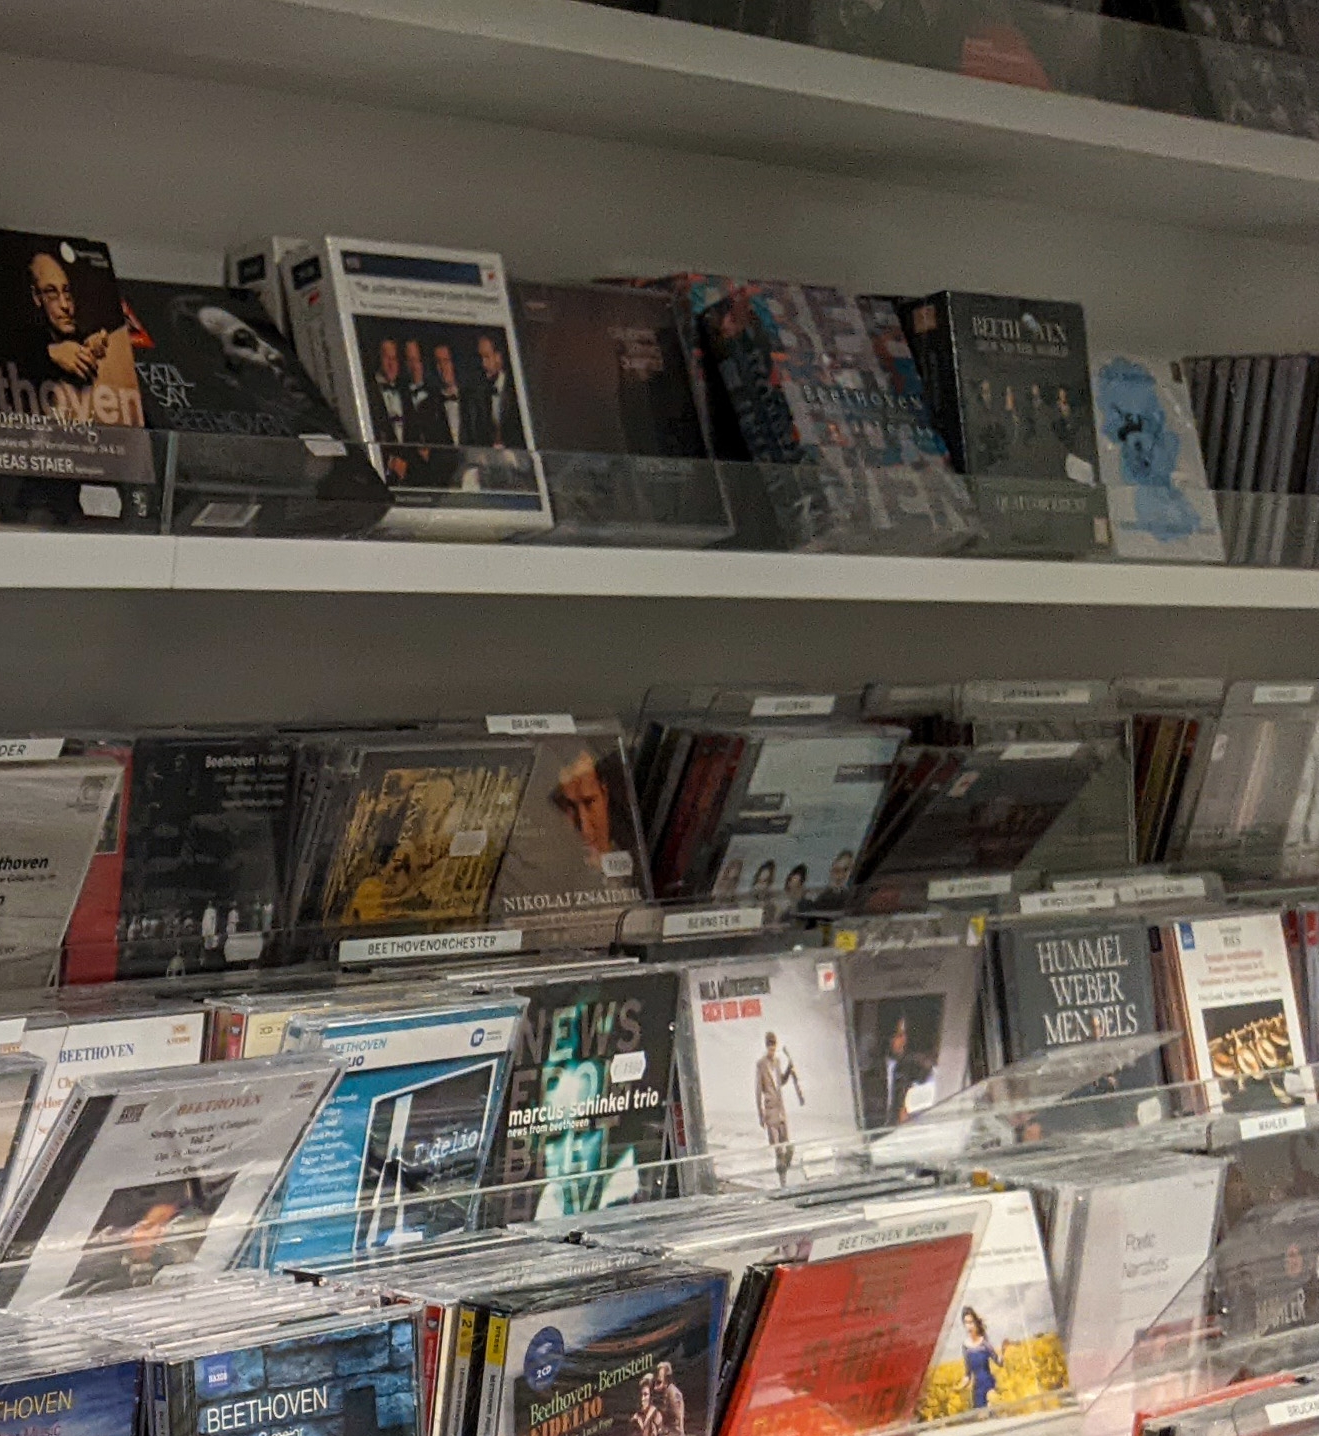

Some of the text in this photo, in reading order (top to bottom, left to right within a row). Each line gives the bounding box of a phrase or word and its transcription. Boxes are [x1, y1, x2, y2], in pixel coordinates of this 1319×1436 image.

[150, 384, 191, 409] SAY
[31, 456, 74, 472] STAIER
[367, 934, 497, 957] BEETHOVENORCHESTER
[1036, 935, 1128, 974] HUMMEL
[1048, 971, 1127, 1007] WEBER
[1043, 1005, 1139, 1045] MENDELS
[58, 1043, 135, 1064] BEETHOVEN
[508, 1088, 658, 1127] marcus schinkel trio
[507, 1117, 589, 1138] news from beethoven
[837, 1226, 903, 1252] BEETHOVEN
[530, 1352, 653, 1426] Beethoven Bernstein
[207, 1387, 328, 1434] BEETHOVEN
